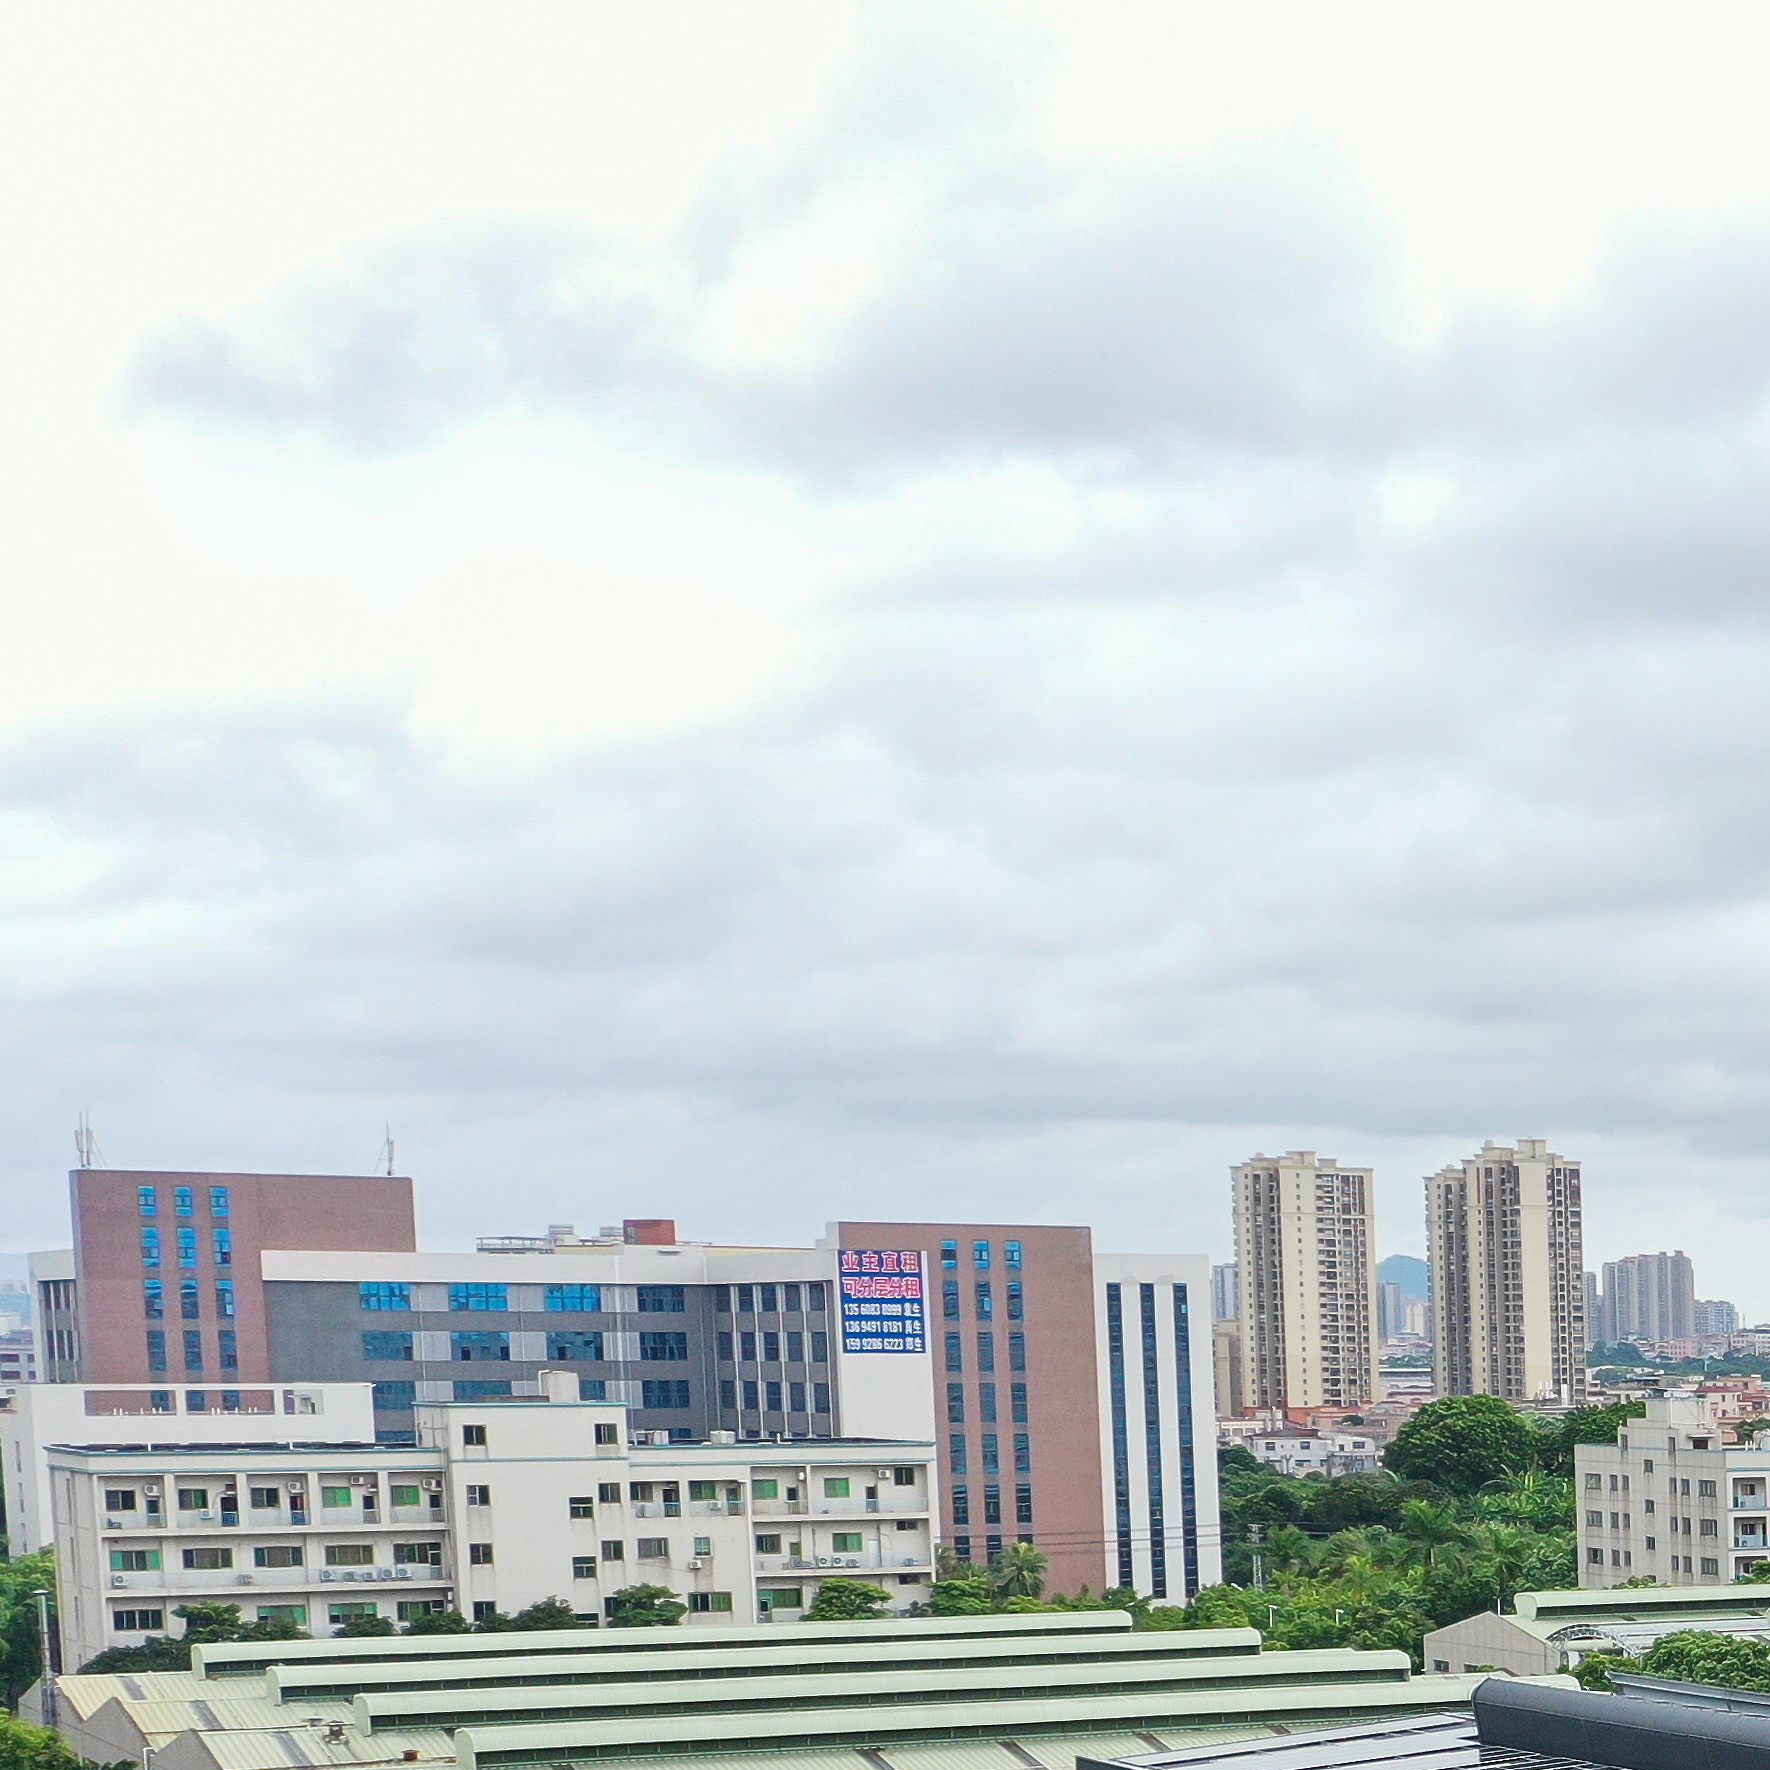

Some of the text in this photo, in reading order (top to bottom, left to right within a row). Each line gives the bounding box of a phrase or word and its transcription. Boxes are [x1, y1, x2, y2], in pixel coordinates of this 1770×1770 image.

[842, 1251, 919, 1272] 业主直租
[842, 1276, 920, 1298] 可分层分租
